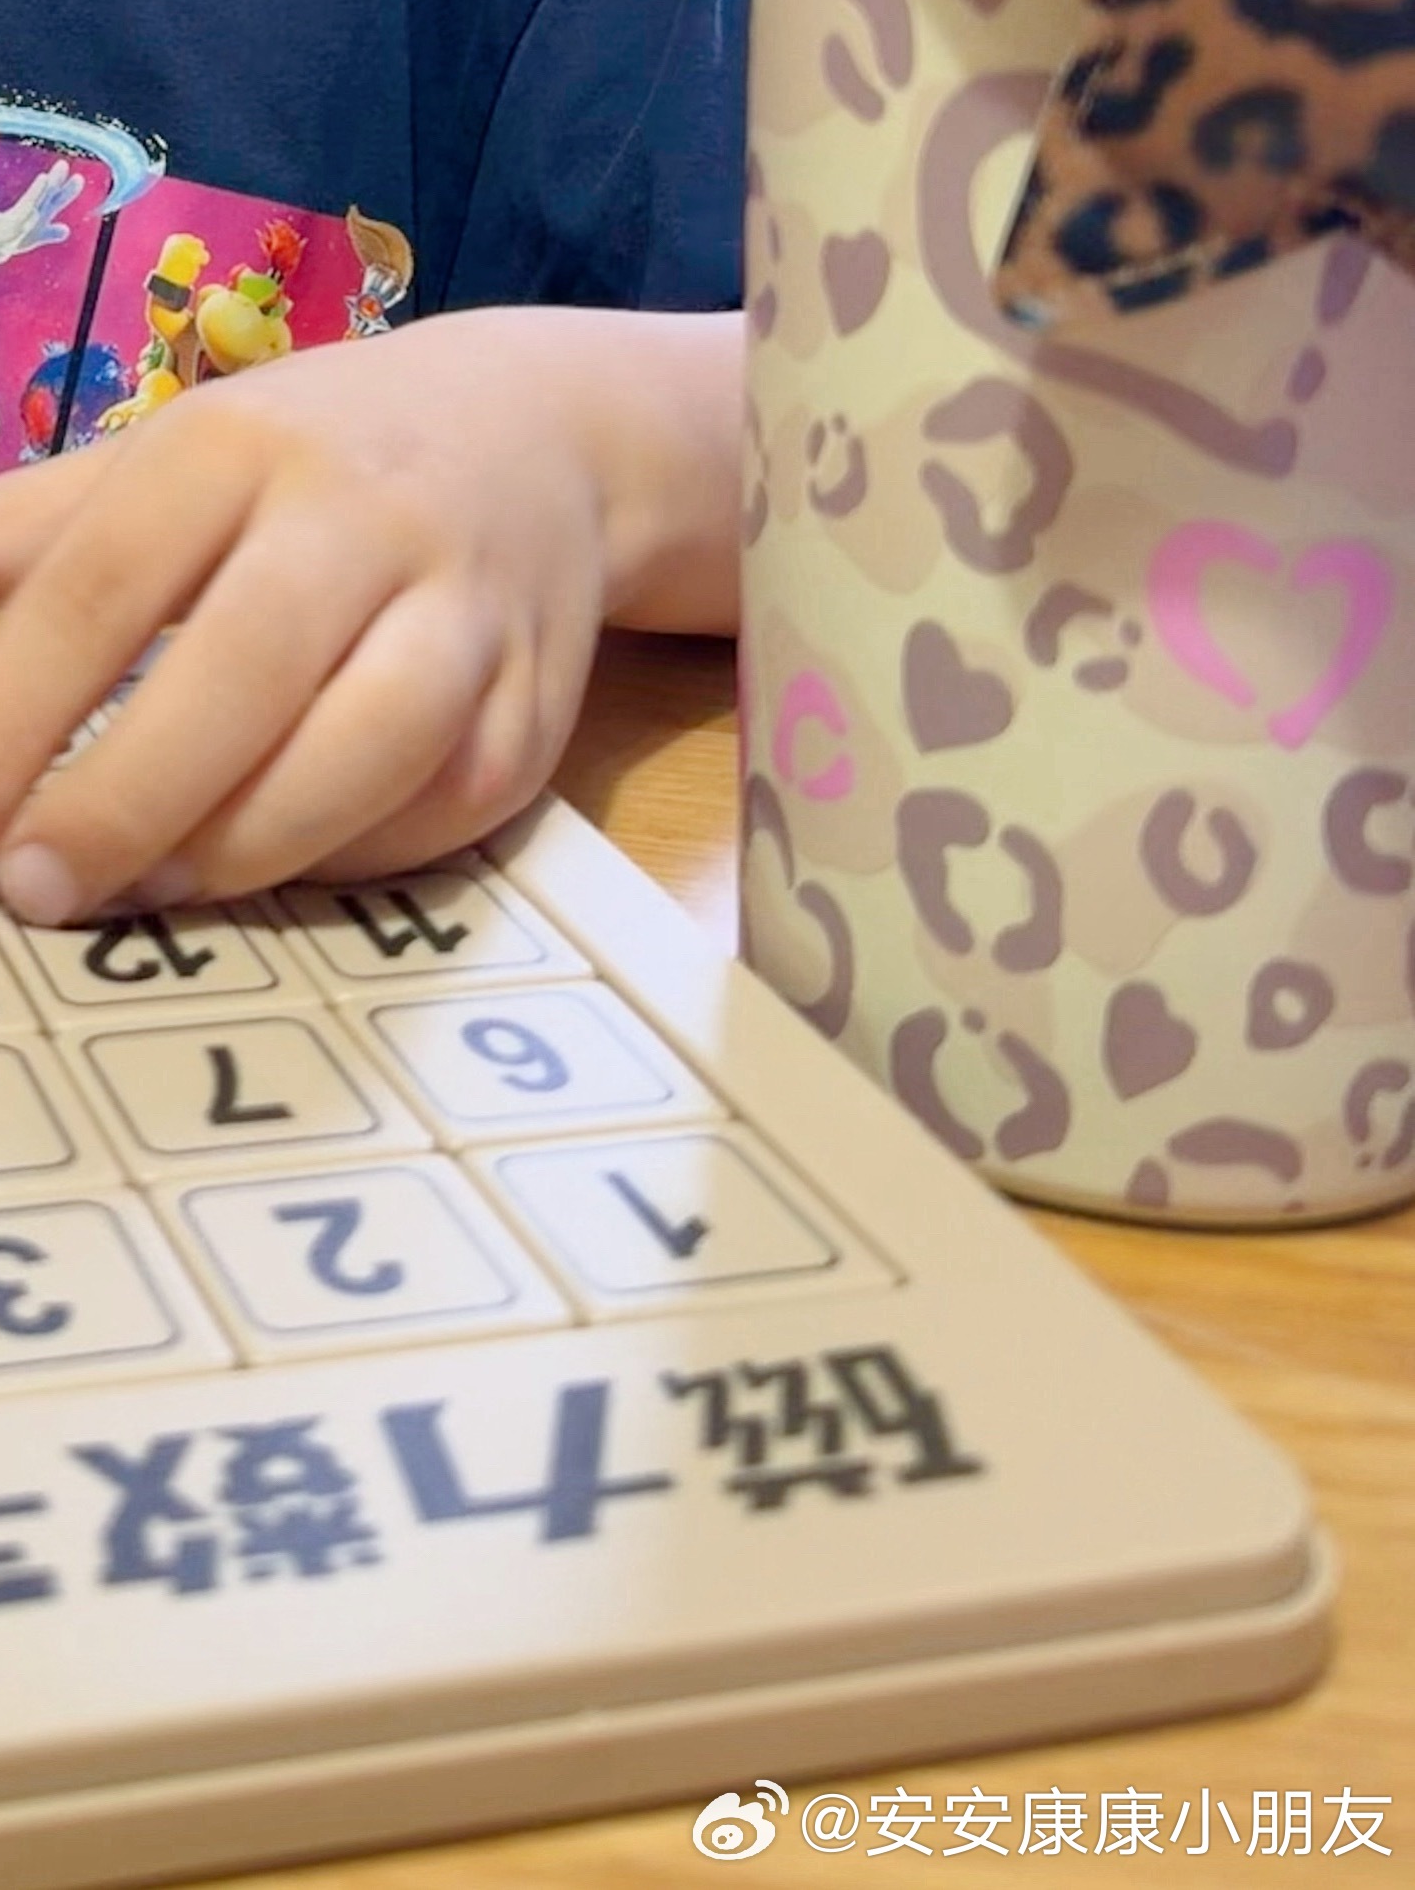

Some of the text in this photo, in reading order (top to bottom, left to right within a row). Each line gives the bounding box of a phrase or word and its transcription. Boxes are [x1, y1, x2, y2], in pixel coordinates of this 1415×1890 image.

[83, 910, 217, 984] 12
[335, 890, 470, 959] 11
[206, 1045, 293, 1127] 7
[458, 1016, 572, 1095] 6
[272, 1198, 404, 1297] 2
[606, 1166, 713, 1261] 1
